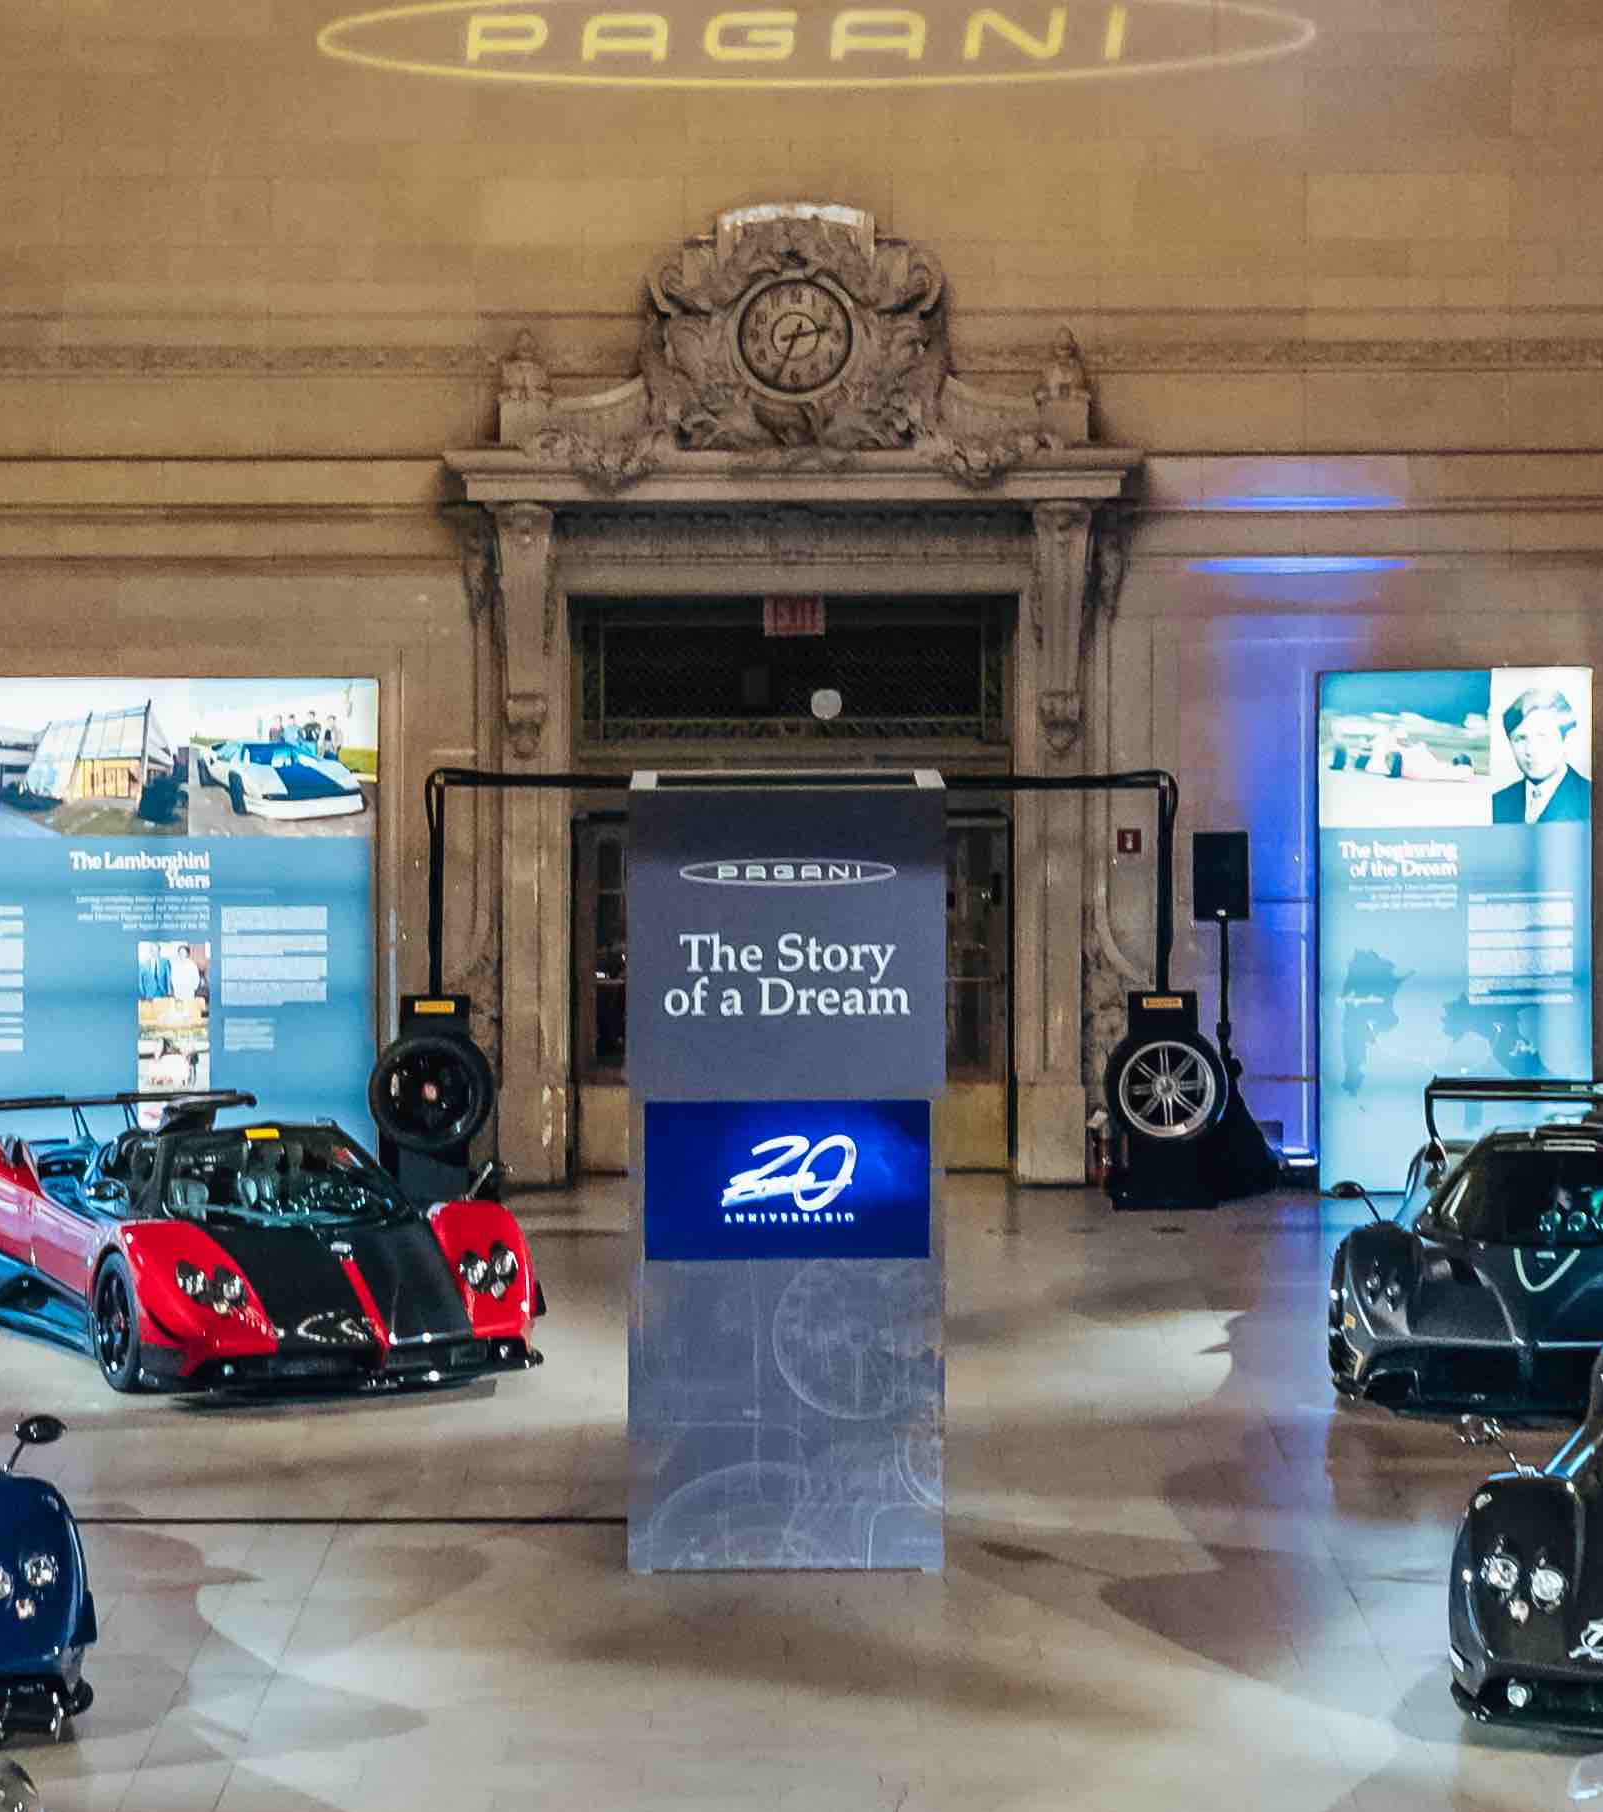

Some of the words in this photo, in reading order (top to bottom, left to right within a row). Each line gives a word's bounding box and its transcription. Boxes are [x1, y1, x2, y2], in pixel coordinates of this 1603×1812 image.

[464, 5, 1127, 65] PAGANI
[69, 851, 102, 870] The
[105, 851, 210, 873] Lamborghini
[1339, 840, 1371, 859] The
[1373, 840, 1459, 862] beginning
[717, 864, 862, 880] PAGANI
[1350, 860, 1368, 877] of
[1371, 860, 1398, 877] the
[1401, 861, 1459, 877] Dream
[164, 871, 211, 889] Years
[679, 931, 765, 973] The
[777, 932, 897, 984] Story
[663, 976, 710, 1017] of
[719, 986, 744, 1017] a
[757, 977, 911, 1017] Dream
[729, 1133, 858, 1212] 20
